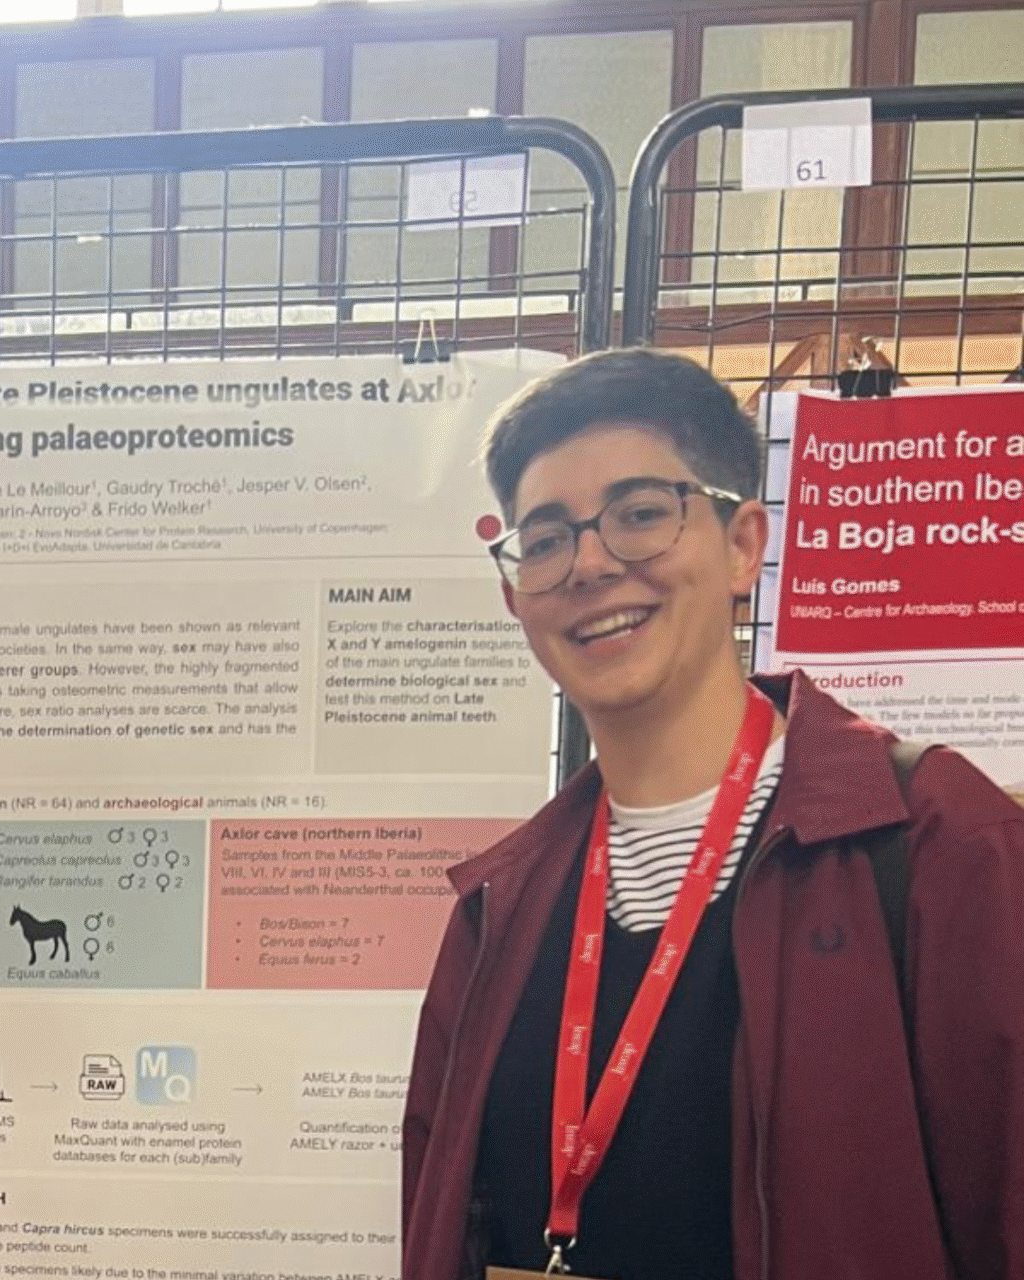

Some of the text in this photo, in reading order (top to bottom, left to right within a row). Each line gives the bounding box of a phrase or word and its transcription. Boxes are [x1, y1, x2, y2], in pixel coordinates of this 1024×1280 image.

[796, 159, 827, 181] 61
[26, 379, 199, 402] Pleistocene
[206, 376, 352, 408] ungulates
[360, 378, 390, 402] at
[30, 418, 294, 457] palaeoproteomics
[802, 432, 946, 470] Argument
[955, 430, 998, 458] for
[5, 482, 26, 497] Le
[105, 478, 164, 499] Gaudry
[236, 477, 290, 495] Jesper
[799, 476, 820, 505] in
[828, 475, 964, 506] southern
[90, 502, 103, 516] &
[106, 500, 148, 516] Frido
[796, 520, 829, 549] La
[838, 518, 915, 554] Boja
[831, 577, 901, 595] Gomes
[328, 587, 412, 603] MAIN AIM
[977, 601, 1016, 614] School
[326, 619, 378, 634] Explore
[380, 620, 403, 632] the
[326, 637, 467, 653] X and Y amelogenin
[324, 674, 527, 690] determine biological sex and
[813, 671, 904, 689] roduction
[452, 692, 484, 704] Late
[323, 710, 497, 722] Pleistocene animal teeth
[102, 796, 204, 811] archaeological
[219, 826, 422, 841] Axlor cave (northern Iberia)
[140, 1051, 168, 1079] M
[86, 1079, 117, 1090] RAW
[164, 1075, 191, 1104] Q
[69, 1116, 226, 1134] Raw data analysed using
[298, 1120, 388, 1134] Quantification
[288, 1137, 375, 1150] AMELY razor
[51, 1150, 116, 1162] databases
[118, 1150, 137, 1162] for
[138, 1152, 170, 1163] each
[21, 1221, 60, 1236] Capra
[62, 1223, 104, 1236] hircus
